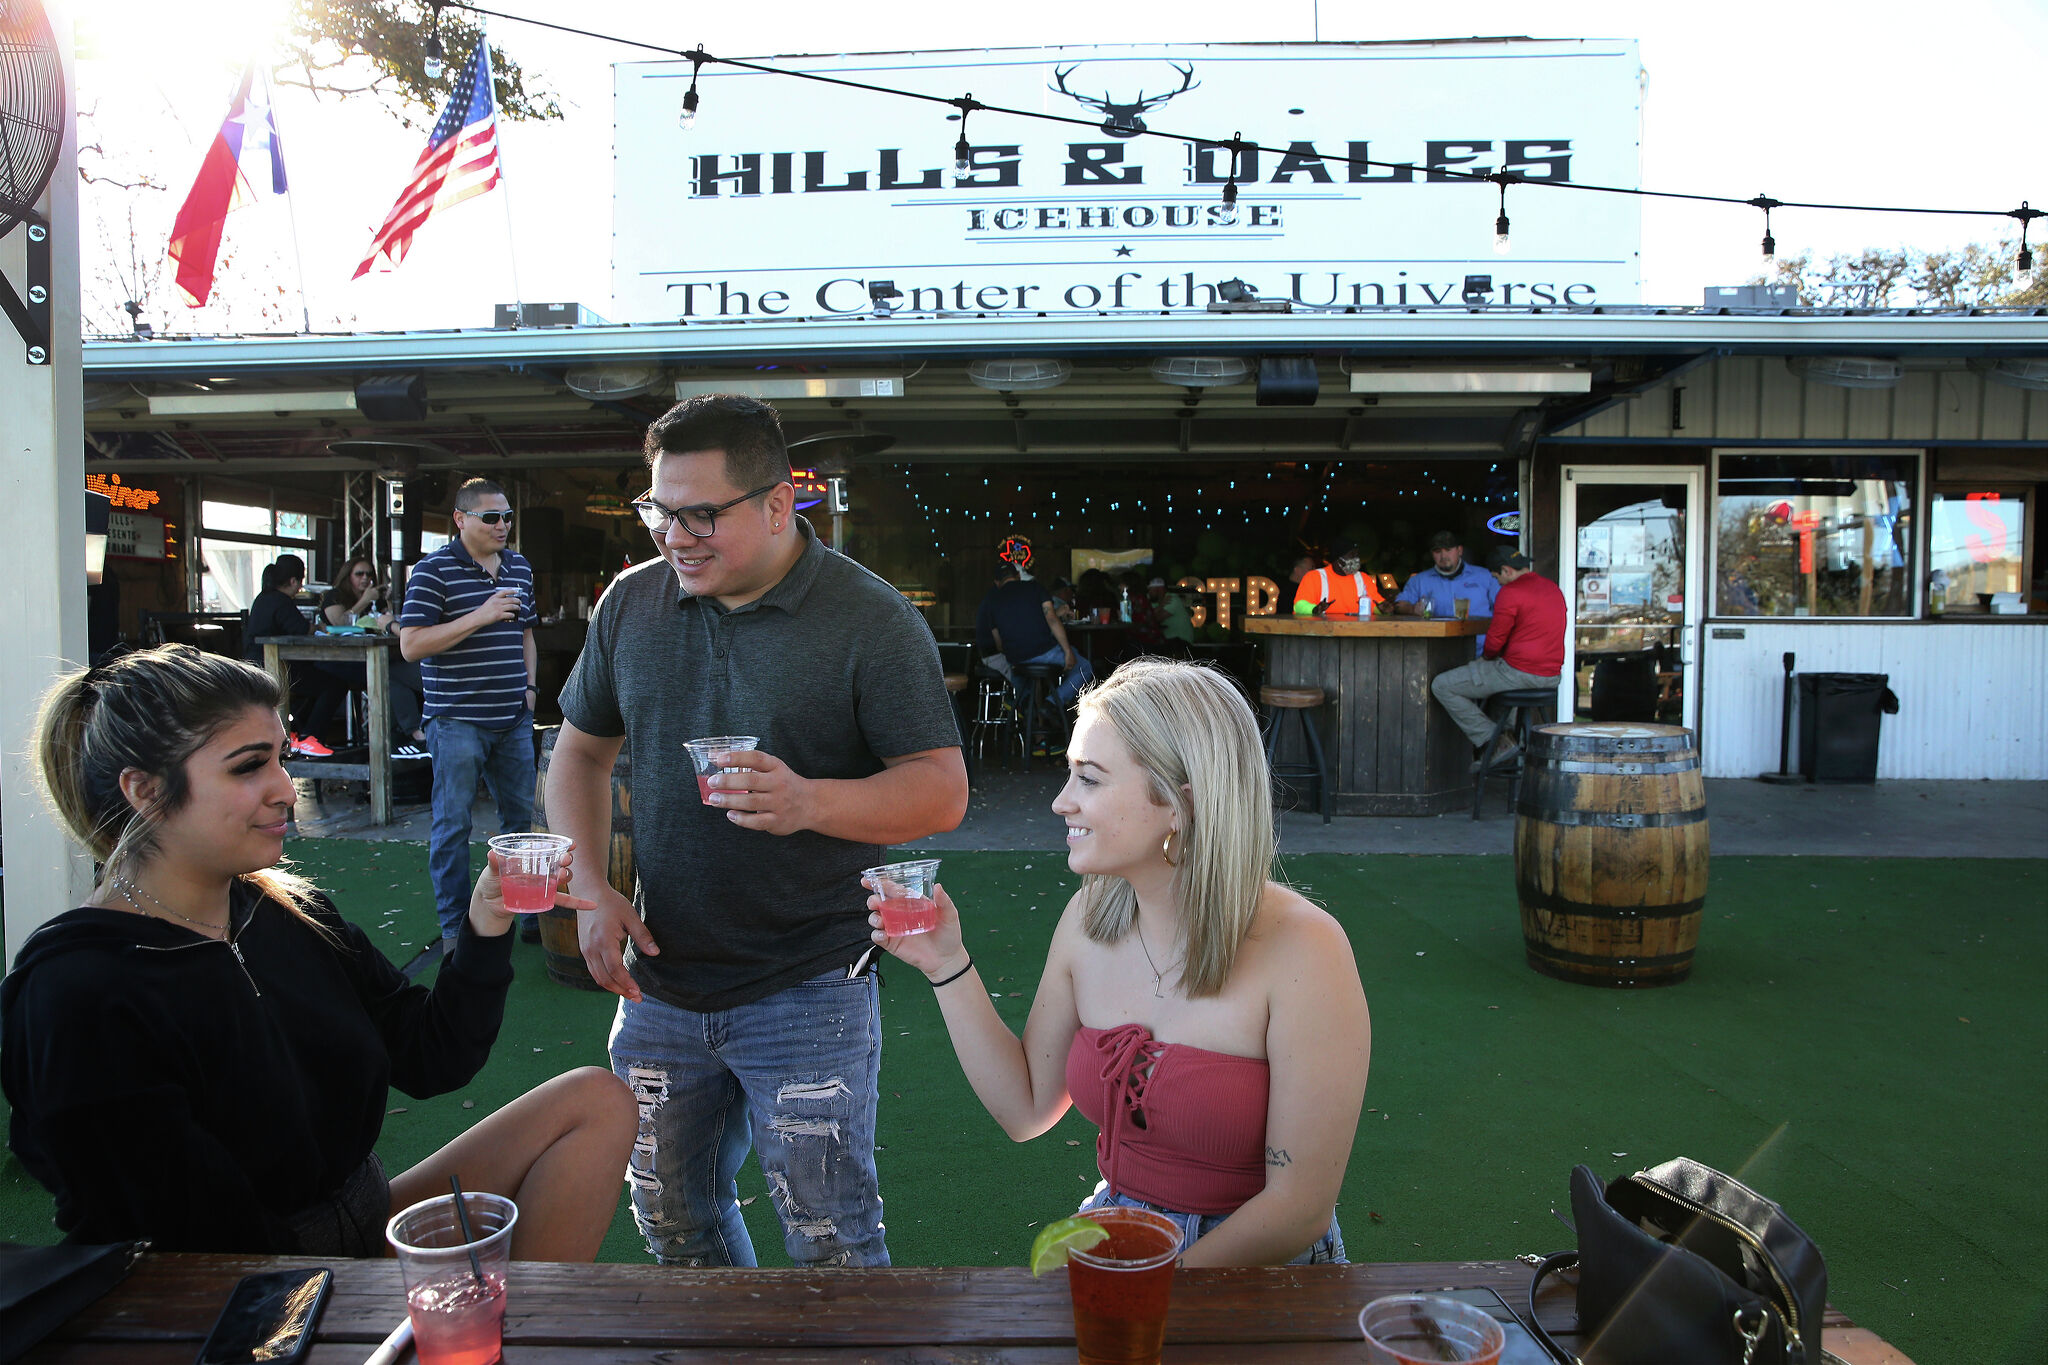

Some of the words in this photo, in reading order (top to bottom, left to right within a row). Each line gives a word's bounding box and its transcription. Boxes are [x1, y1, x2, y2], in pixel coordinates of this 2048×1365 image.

[688, 145, 1023, 199] HILLS
[1061, 142, 1144, 186] &
[1183, 139, 1574, 187] DALES
[966, 204, 1283, 231] ICEHOUSE
[667, 280, 790, 317] The
[1064, 271, 1143, 310] of
[1156, 271, 1259, 308] th
